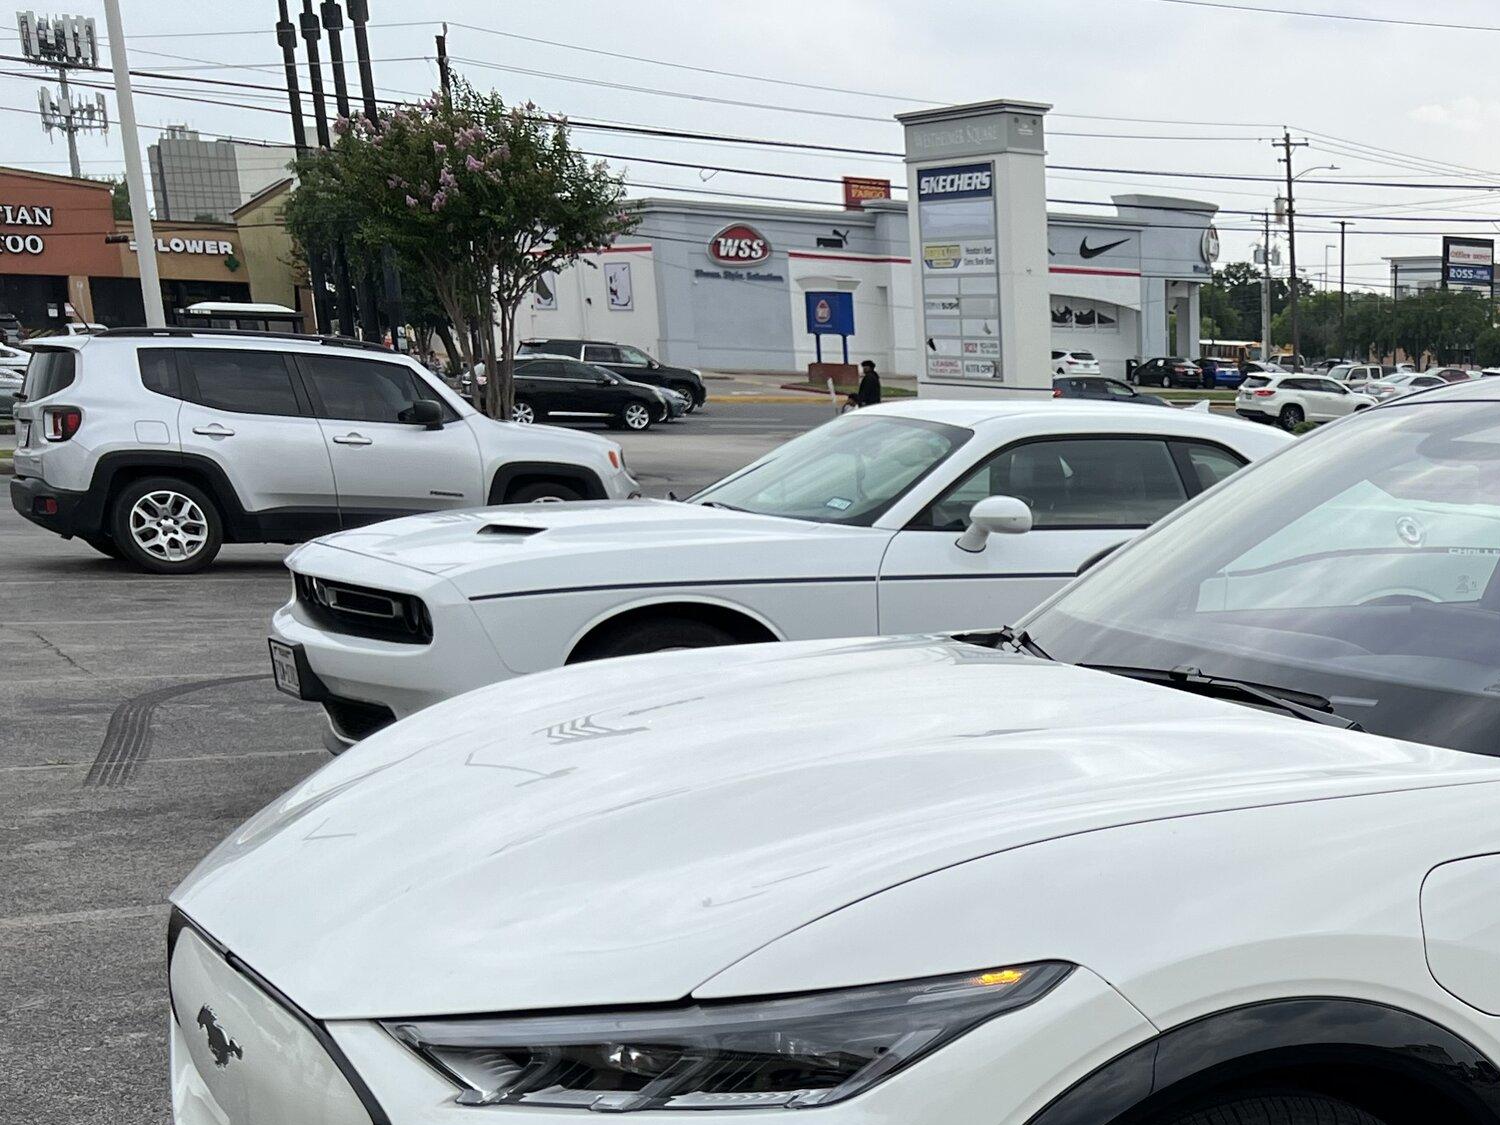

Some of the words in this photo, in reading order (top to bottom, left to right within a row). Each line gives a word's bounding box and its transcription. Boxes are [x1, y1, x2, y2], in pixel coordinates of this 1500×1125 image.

[920, 171, 991, 194] SKECHERS
[0, 206, 52, 226] IAN
[0, 235, 44, 254] OO
[153, 238, 234, 255] LOWER
[717, 238, 764, 258] WSS
[1449, 267, 1474, 279] ROSS
